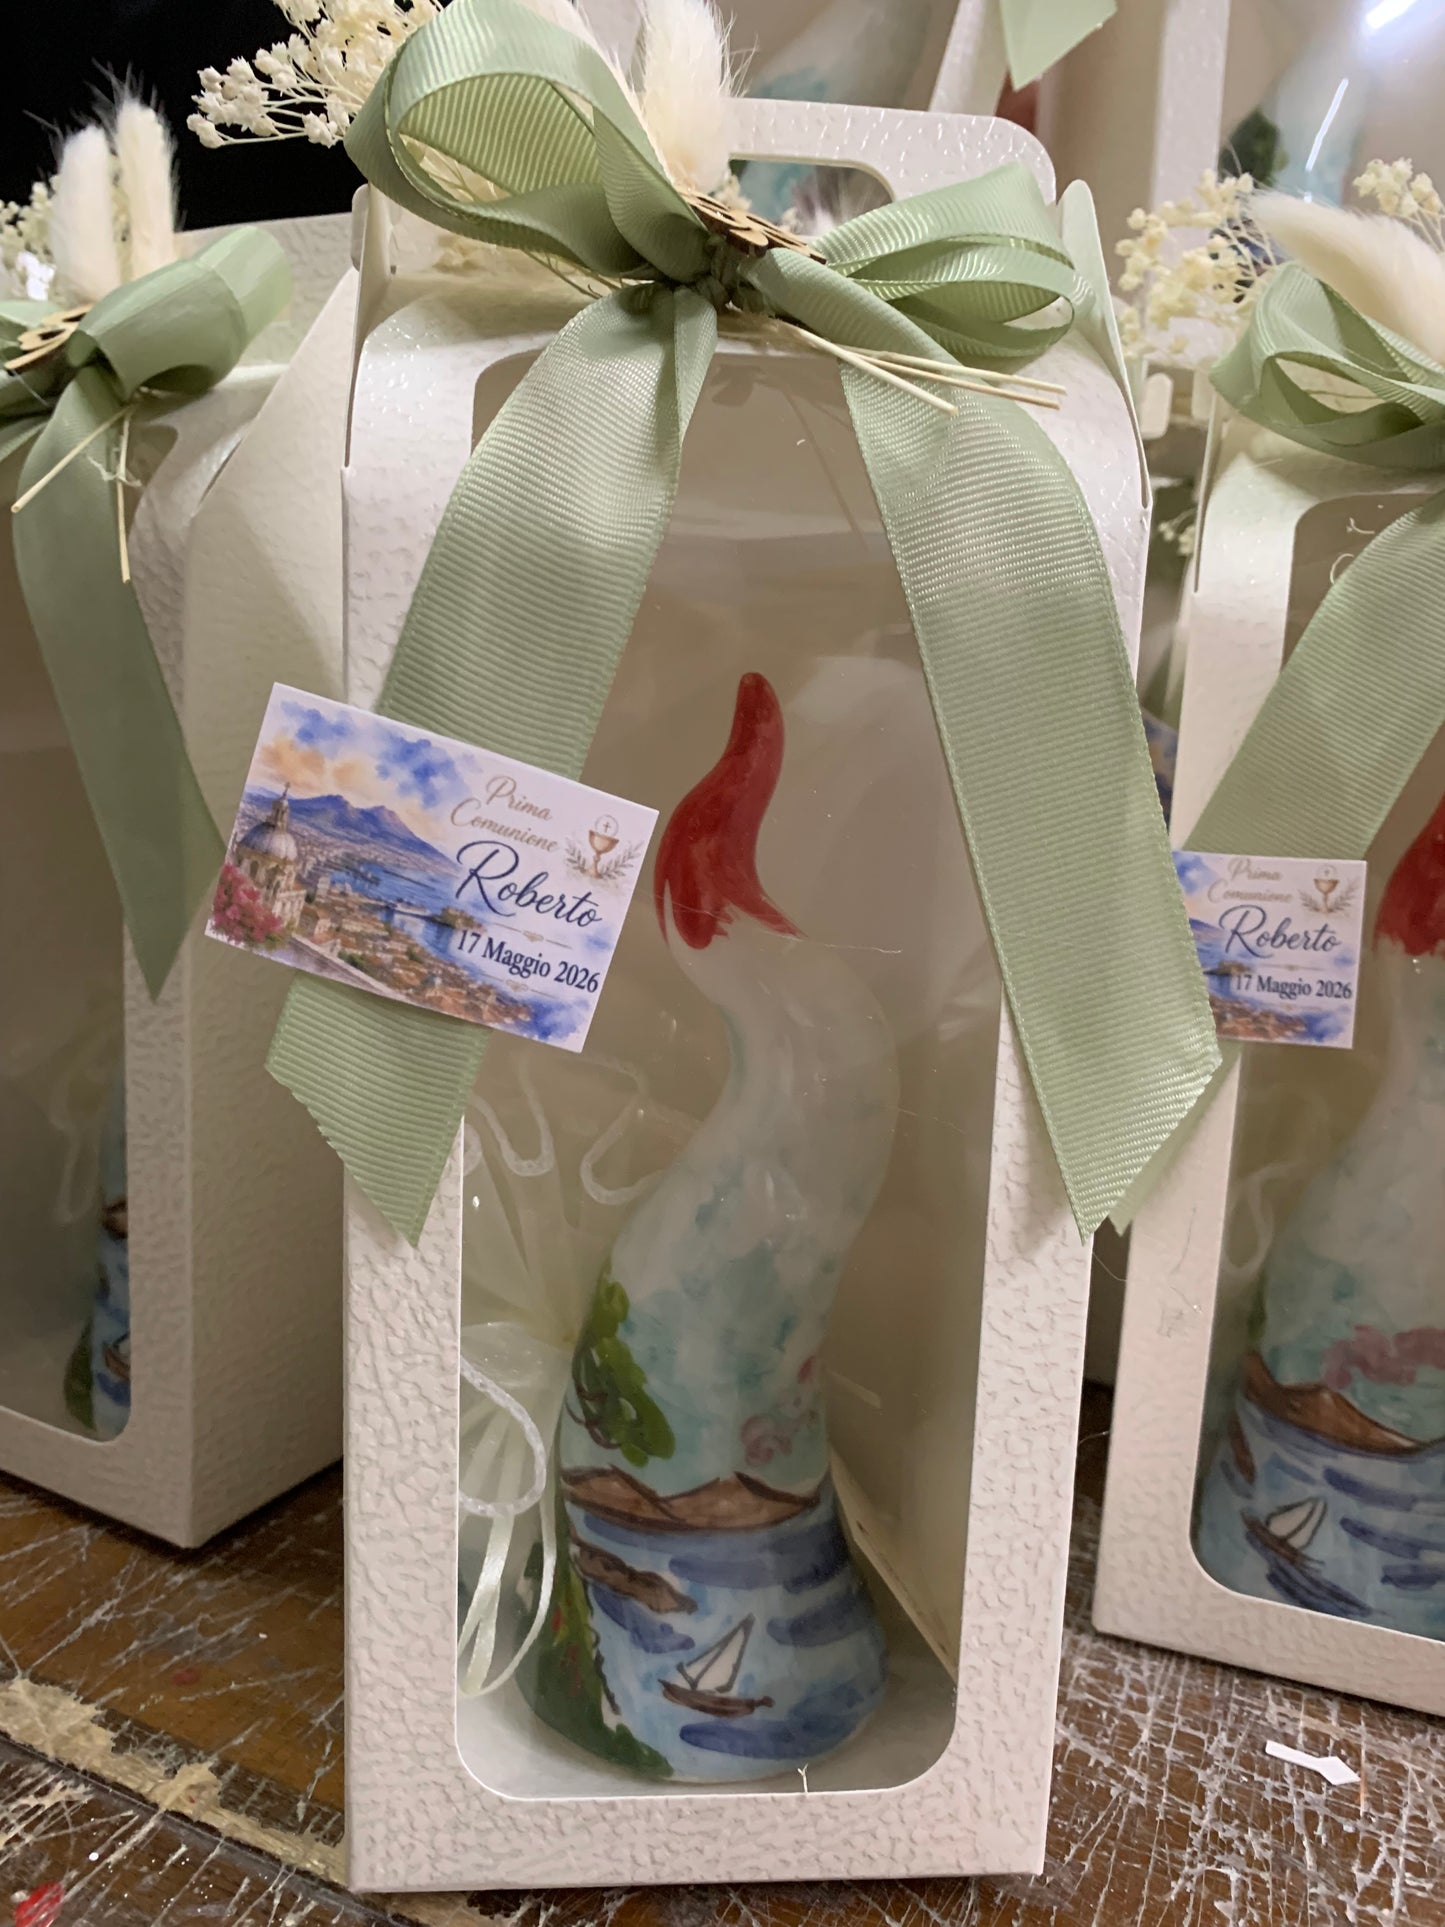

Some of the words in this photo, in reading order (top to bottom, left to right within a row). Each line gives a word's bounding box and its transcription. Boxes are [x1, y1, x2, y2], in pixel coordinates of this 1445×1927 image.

[485, 775, 553, 822] Prima
[450, 797, 559, 854] Comunione
[455, 839, 604, 928] Roberto
[1207, 877, 1294, 904] Comunione
[1227, 857, 1283, 881] Prima
[1218, 903, 1342, 959] Roberto
[457, 929, 481, 954] 17
[482, 938, 552, 979] Maggio
[553, 961, 600, 993] 2026
[1235, 974, 1252, 991] 17
[1256, 974, 1312, 1000] Maggio
[1316, 979, 1353, 999] 2026
